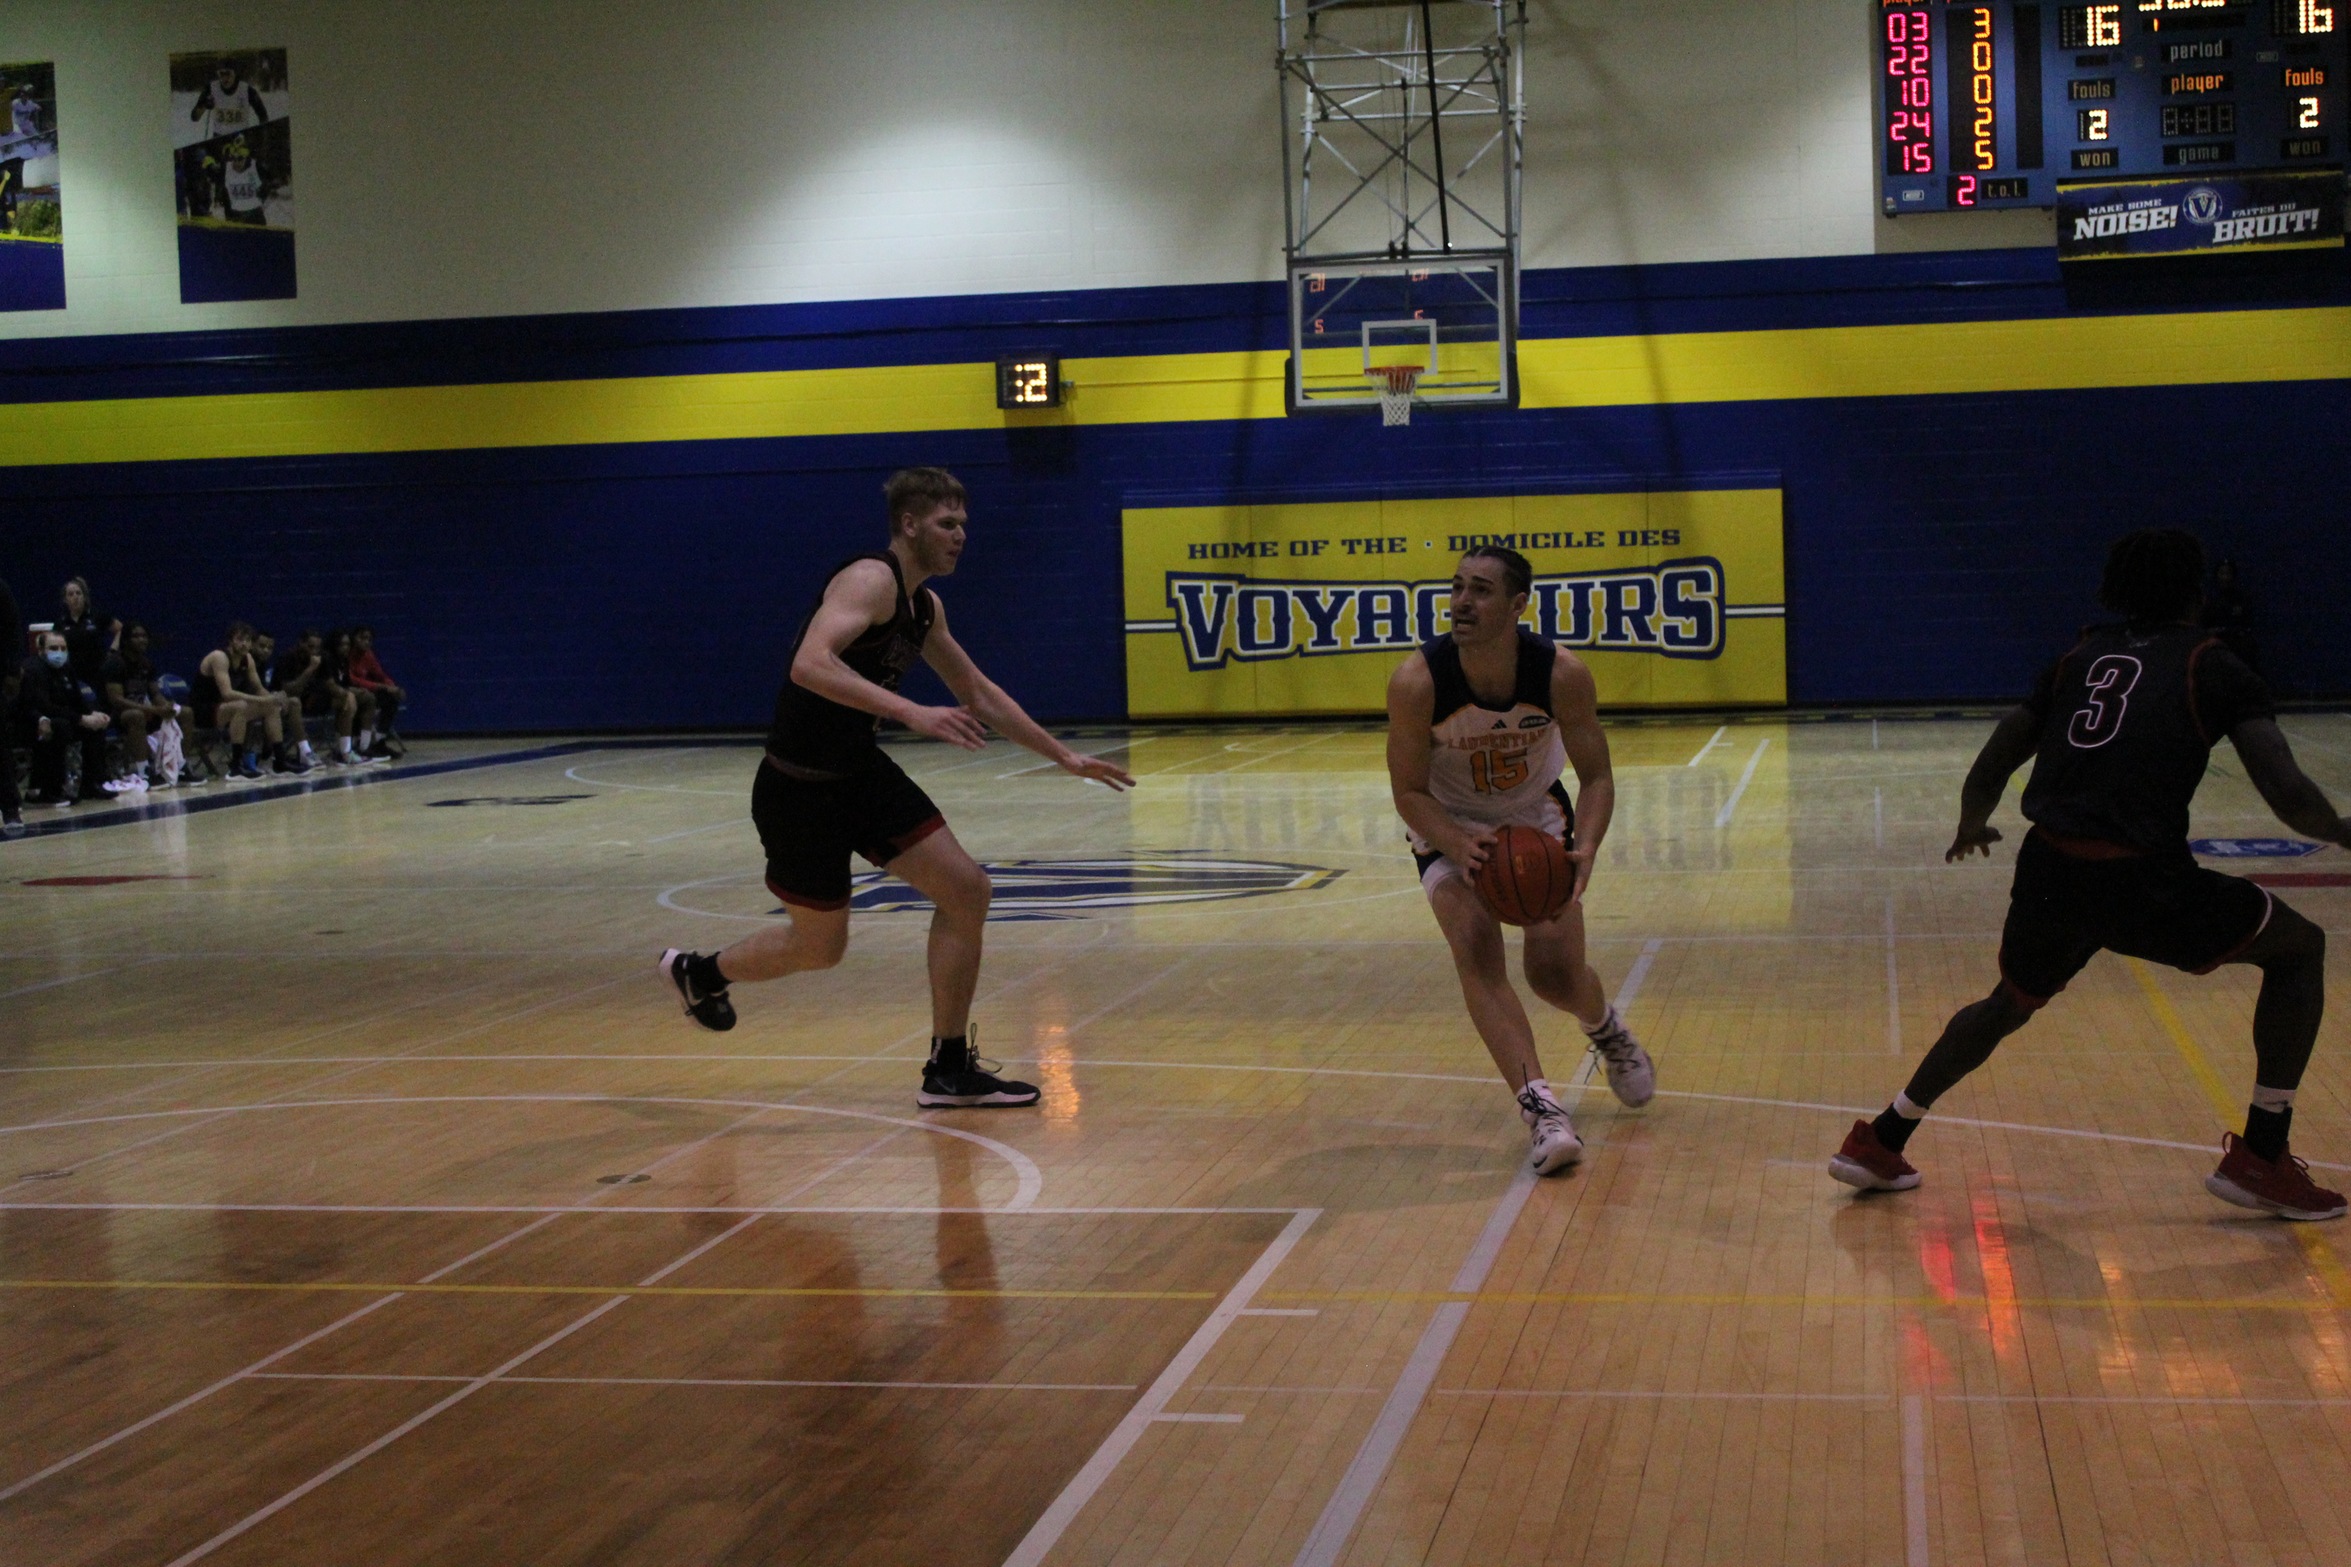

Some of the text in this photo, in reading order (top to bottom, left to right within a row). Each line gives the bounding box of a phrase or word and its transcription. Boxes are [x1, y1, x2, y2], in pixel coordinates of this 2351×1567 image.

[1887, 7, 1991, 43] 03 3
[2086, 4, 2121, 47] 16
[2299, 0, 2333, 34] 16
[1888, 41, 1992, 76] 22 0
[2170, 39, 2223, 63] period
[1901, 73, 1993, 107] 10 0
[2072, 80, 2111, 99] fouls
[2170, 72, 2225, 96] player
[2285, 67, 2325, 88] fouls
[1889, 106, 1993, 141] 24 2
[2088, 108, 2108, 141] 2
[2298, 97, 2320, 129] 2
[1903, 139, 1994, 173] 15 5
[2079, 150, 2111, 167] won
[2178, 146, 2220, 166] game
[2289, 139, 2321, 156] won
[1957, 174, 1977, 206] 2
[2088, 198, 2162, 215] MAKE SOME
[2073, 204, 2179, 241] NOISE!
[2212, 207, 2320, 243] BRUIT!
[1187, 536, 1408, 560] HOME OF THE
[1447, 529, 1681, 551] DOMICILE DES
[1172, 562, 1722, 668] VOYAGURS
[2067, 653, 2142, 749] 3
[1470, 747, 1529, 795] 15
